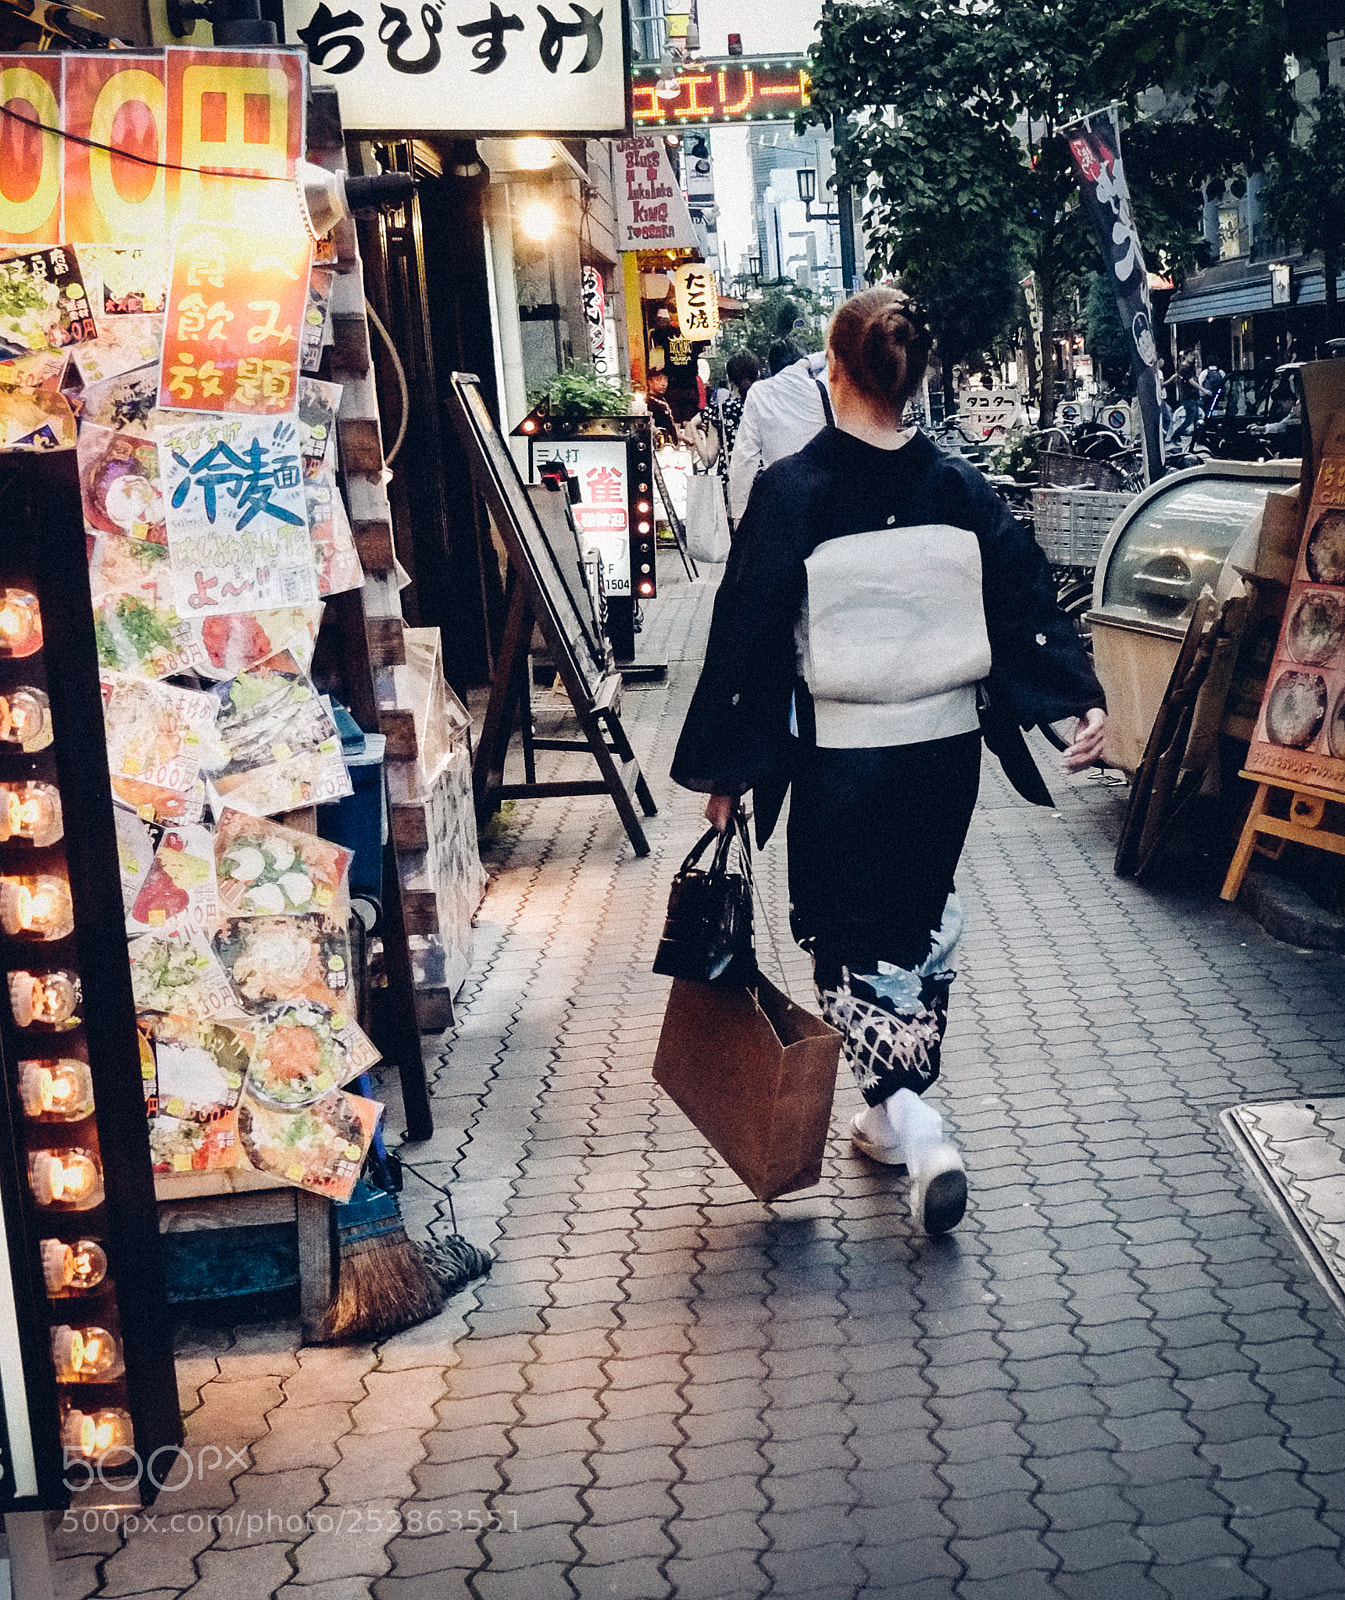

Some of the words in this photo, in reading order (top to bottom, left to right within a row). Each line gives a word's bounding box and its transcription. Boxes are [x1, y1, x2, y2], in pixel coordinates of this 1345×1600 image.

[296, 1, 604, 75] ちびすけ
[178, 293, 297, 345] 飲み
[684, 272, 710, 330] たこ焼
[169, 352, 293, 408] 放題
